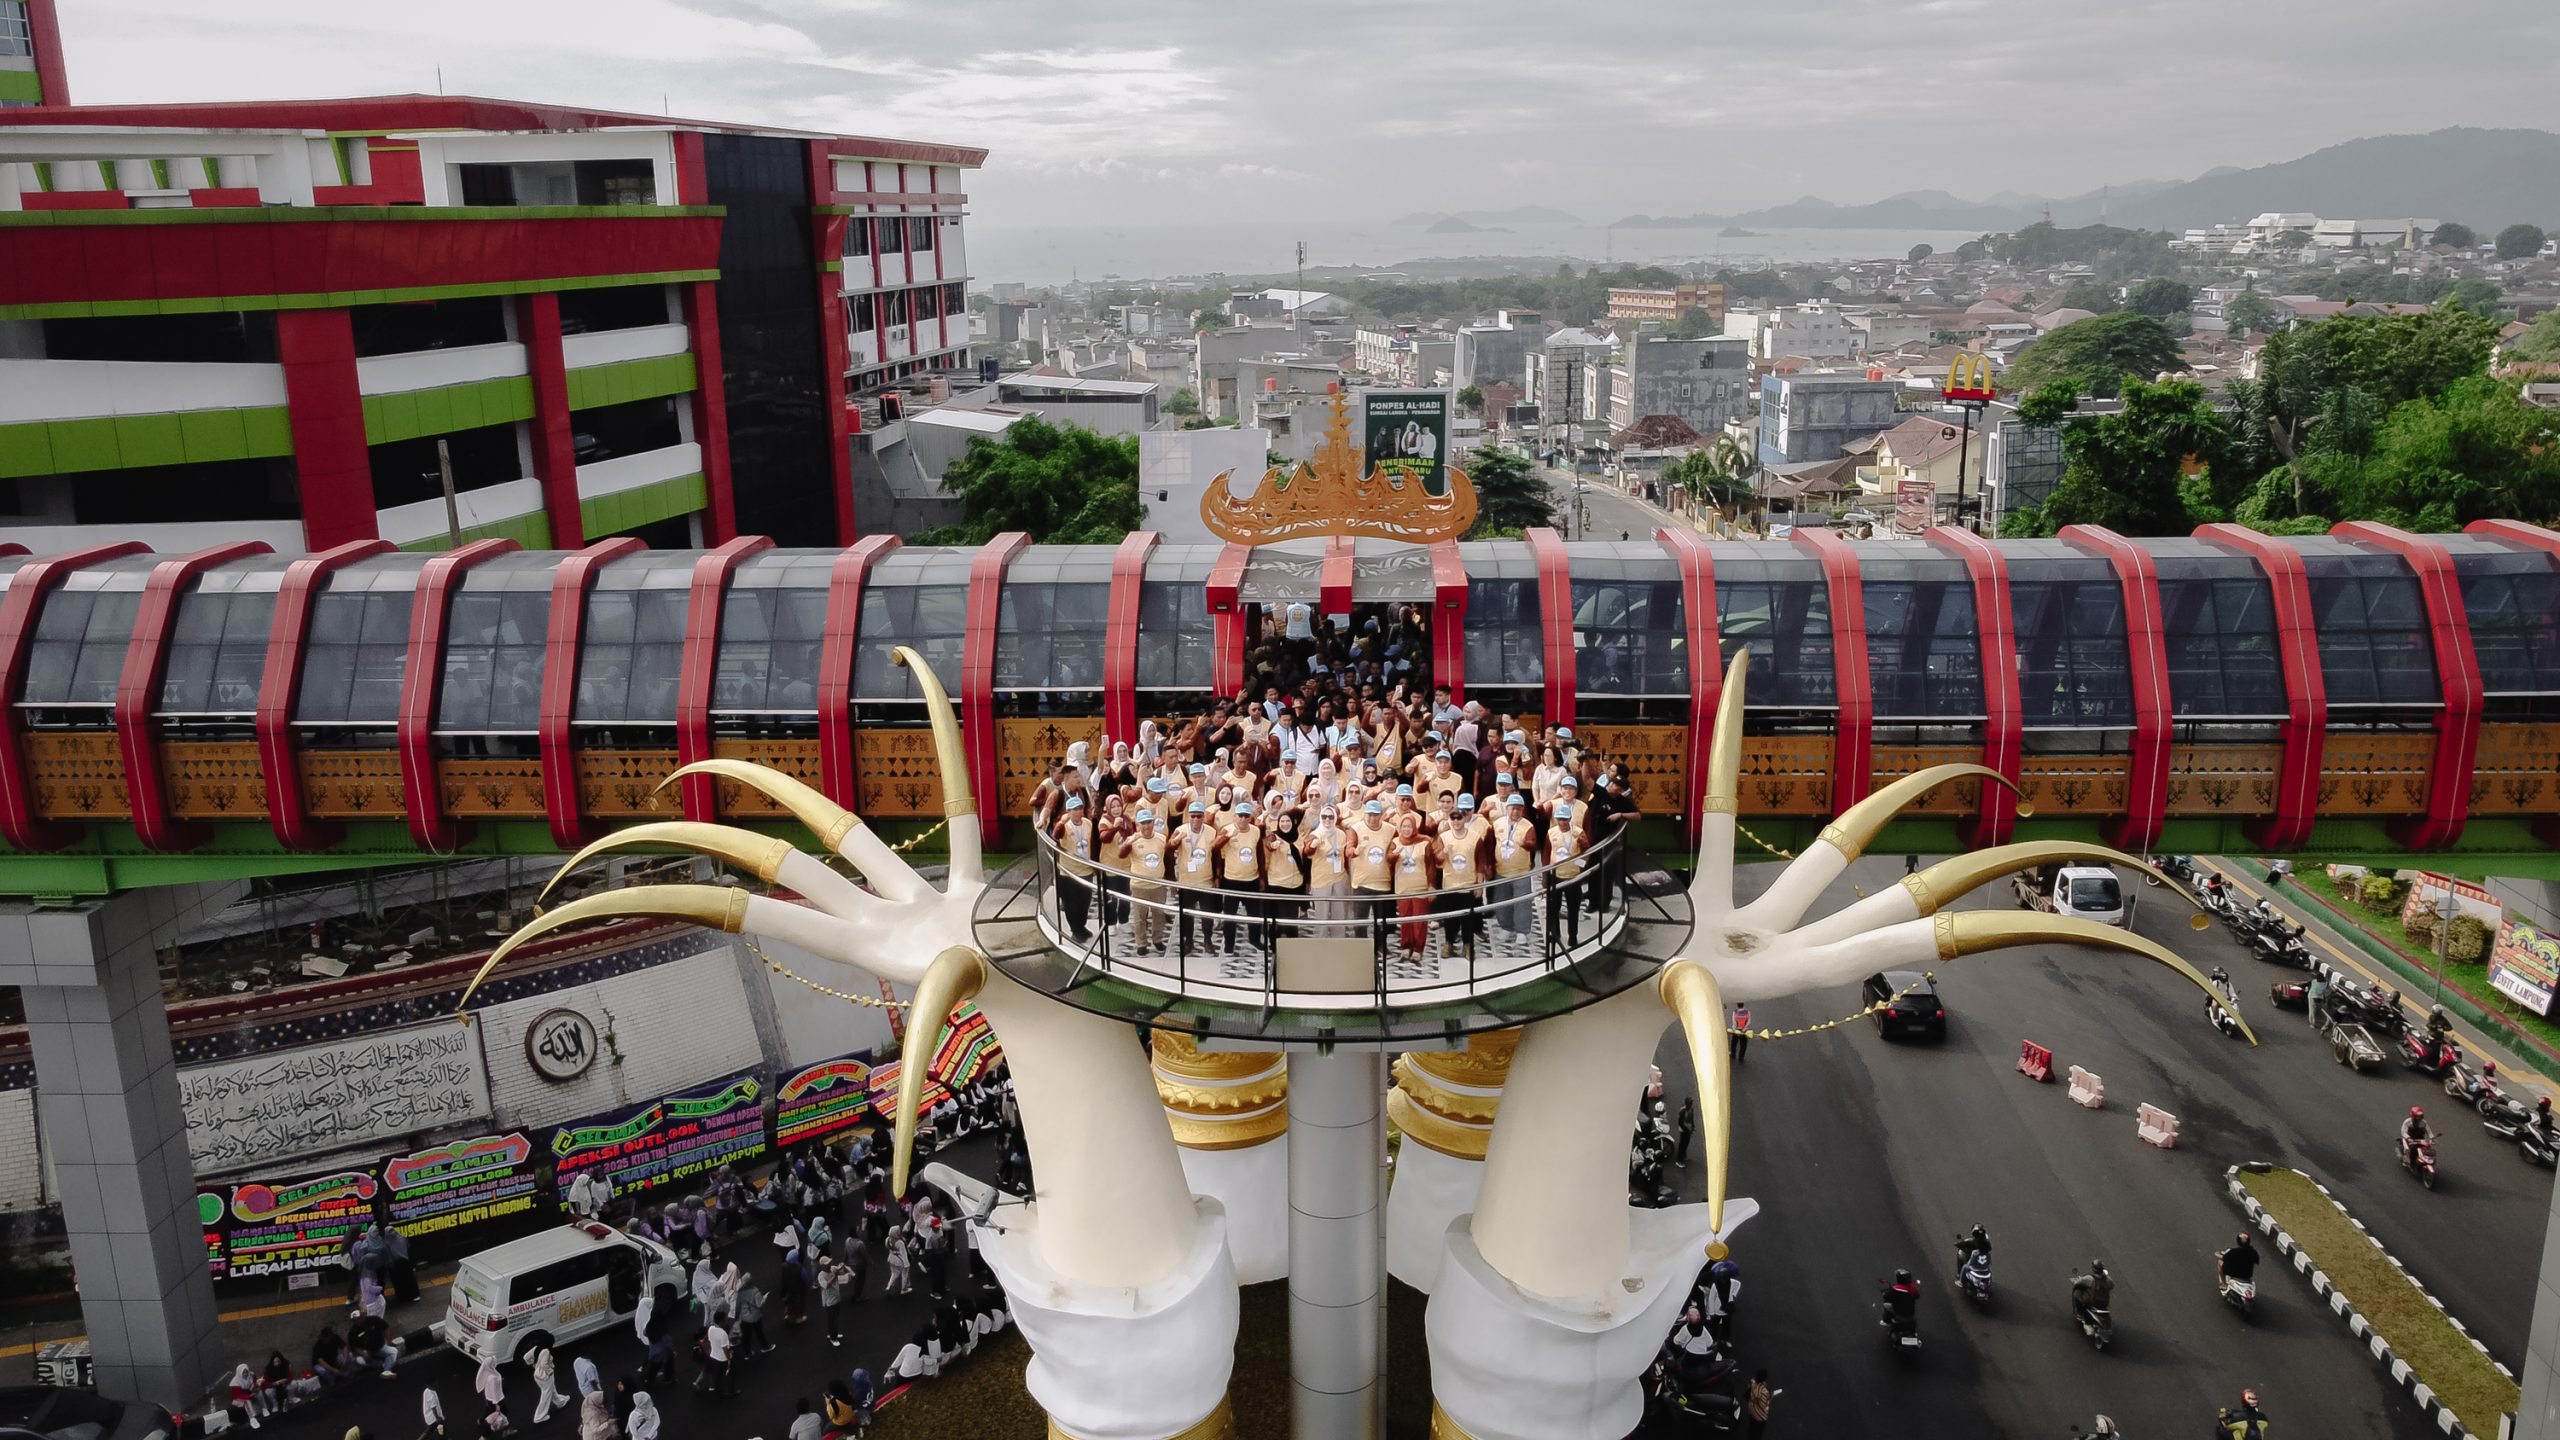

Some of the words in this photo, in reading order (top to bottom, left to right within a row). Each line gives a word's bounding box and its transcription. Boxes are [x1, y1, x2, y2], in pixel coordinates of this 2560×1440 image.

[1370, 402, 1404, 410] PONPES
[1406, 401, 1440, 409] AL-HADI
[1377, 458, 1435, 467] ENERIMAAN
[1415, 467, 1431, 475] ARU
[2514, 983, 2545, 1009] LAMPUNG
[575, 1115, 649, 1145] SELAMAT
[674, 1089, 736, 1113] SUKSES
[406, 1151, 507, 1183] SELAMAT
[556, 1144, 620, 1171] APEKSI
[603, 1158, 629, 1173] 2025
[673, 1162, 703, 1179] KOTA
[278, 1177, 353, 1207] SELAMAT
[395, 1181, 448, 1201] APEKSI
[450, 1167, 513, 1188] OUTLOOK
[348, 1204, 372, 1216] 2025
[458, 1206, 489, 1226] KOTA
[230, 1231, 296, 1248] PERSATUAN
[306, 1222, 368, 1239] KESATN
[229, 1260, 293, 1278] LURAH
[508, 1294, 556, 1316] AMBULANCE
[558, 1287, 608, 1314] PELAYANAN
[452, 1300, 487, 1327] AMBULANCE
[558, 1301, 608, 1325] GRATIS
